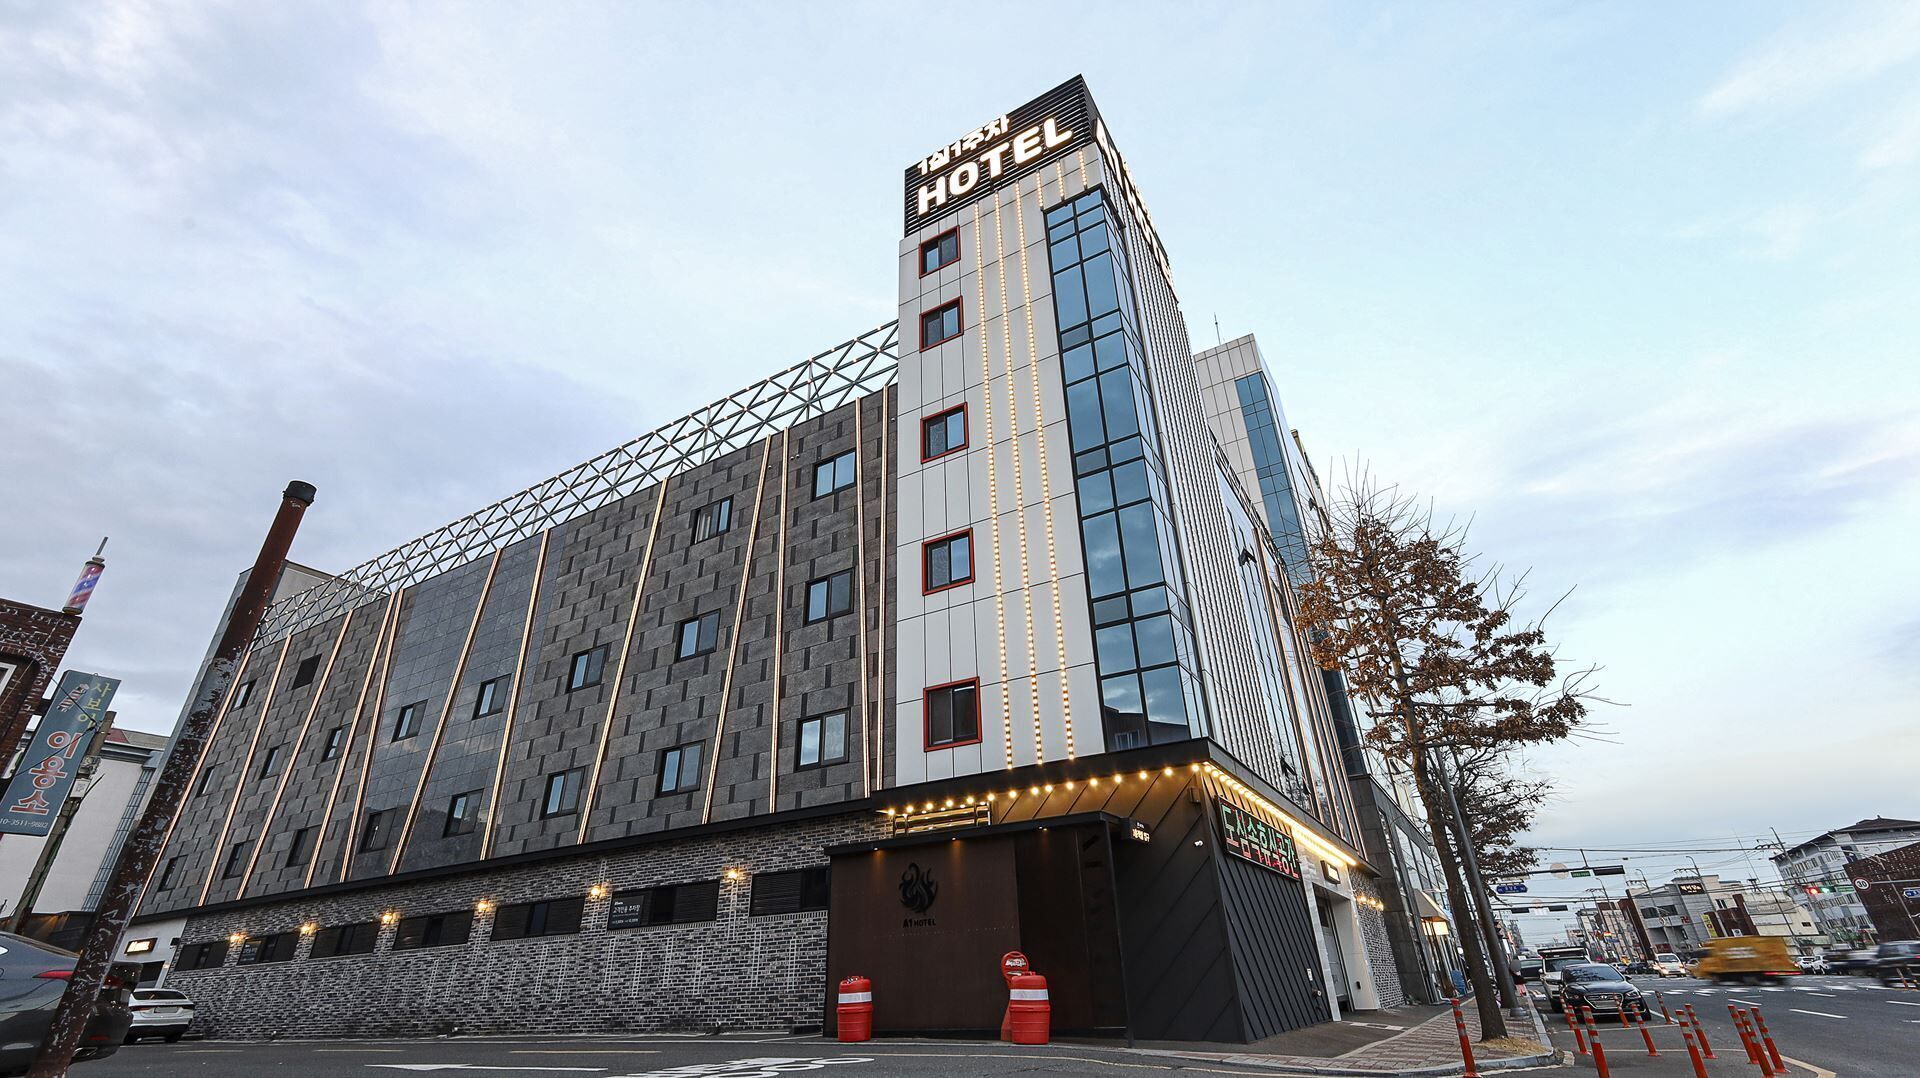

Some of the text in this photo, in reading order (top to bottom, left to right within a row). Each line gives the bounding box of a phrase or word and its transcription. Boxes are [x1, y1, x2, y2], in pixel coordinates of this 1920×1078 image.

[917, 114, 1010, 175] 1실1주차
[917, 117, 1073, 217] HOTEL
[9, 731, 83, 815] 이용소
[1856, 880, 1868, 888] 30
[903, 918, 937, 928] A1 HOTEL
